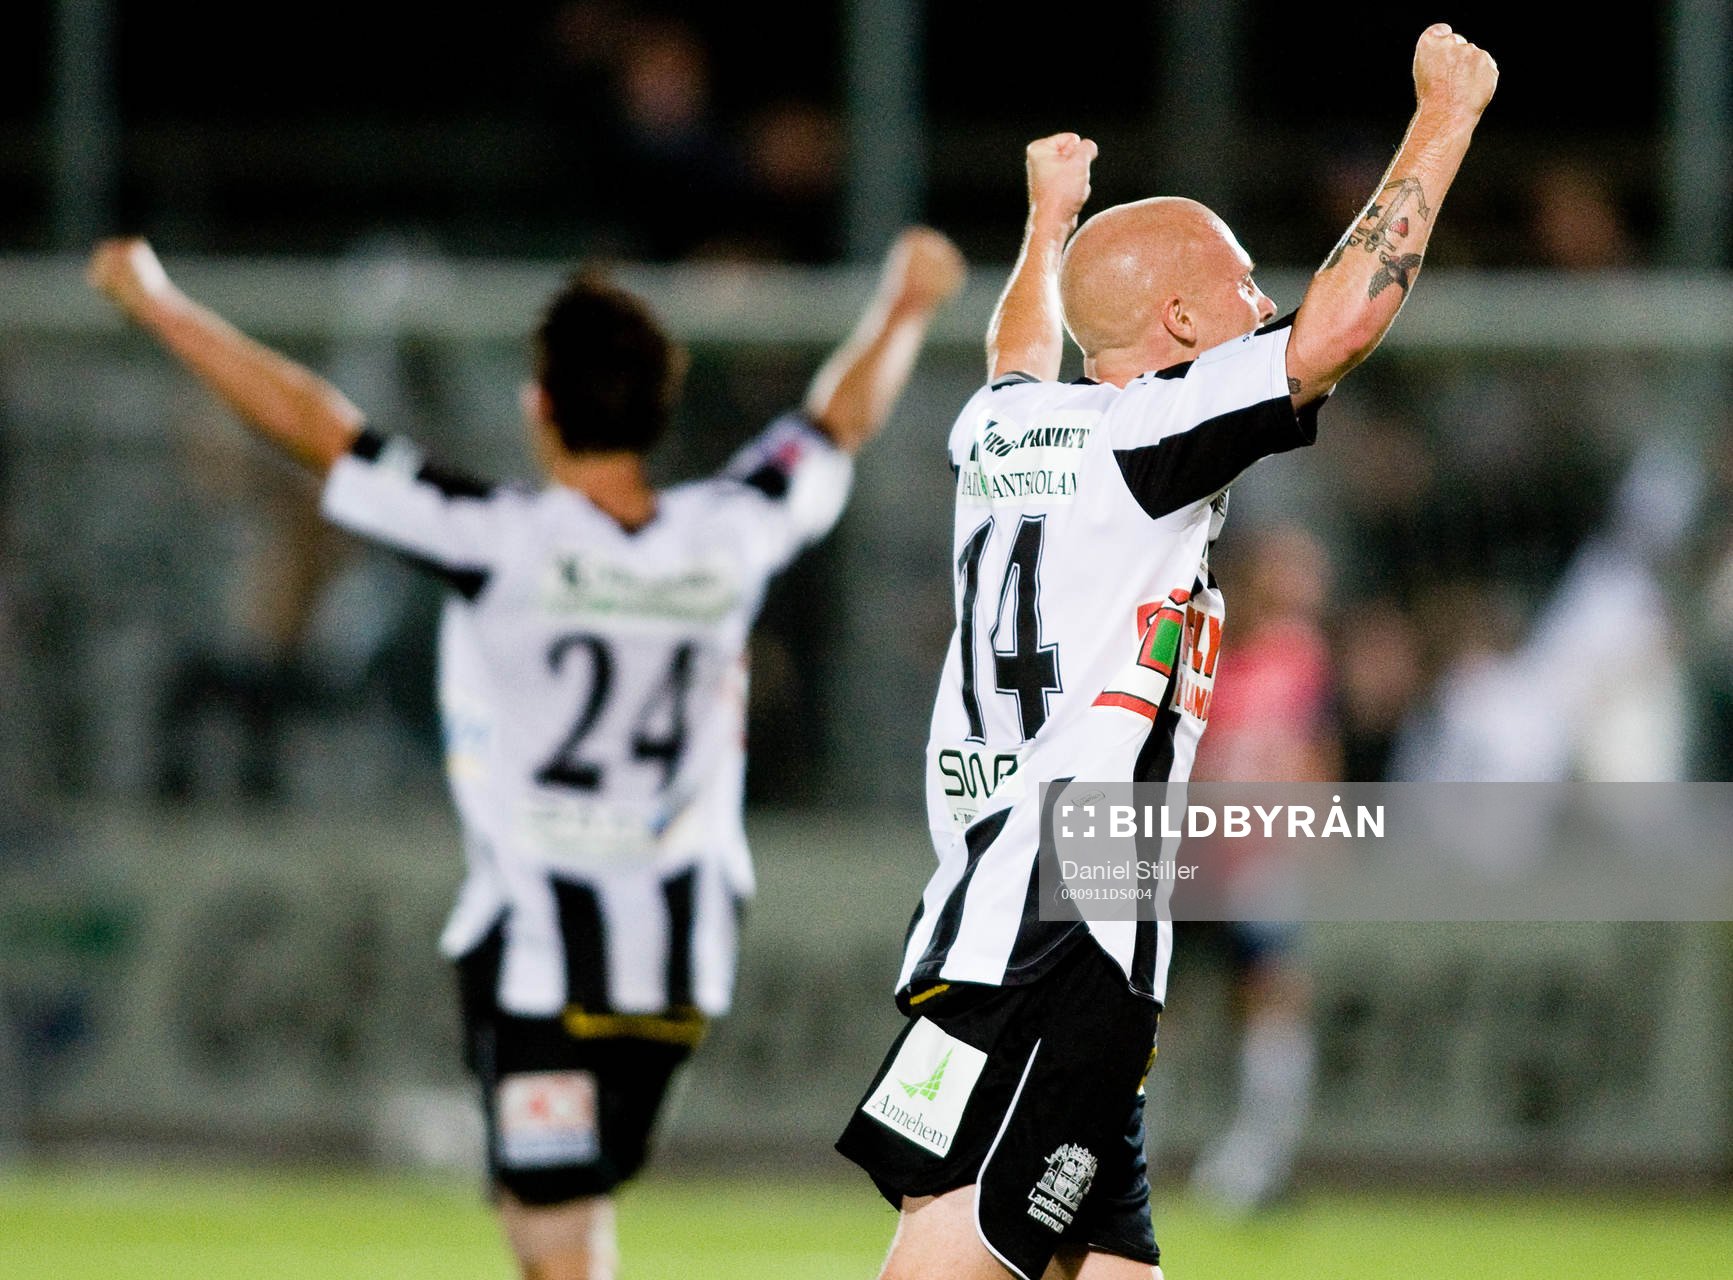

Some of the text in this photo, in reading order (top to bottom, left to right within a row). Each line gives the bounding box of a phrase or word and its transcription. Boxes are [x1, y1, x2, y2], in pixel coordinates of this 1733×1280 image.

[957, 513, 1063, 745] 14
[532, 630, 697, 791] 24
[871, 1093, 949, 1150] Annehem
[1027, 1202, 1065, 1234] kommun
